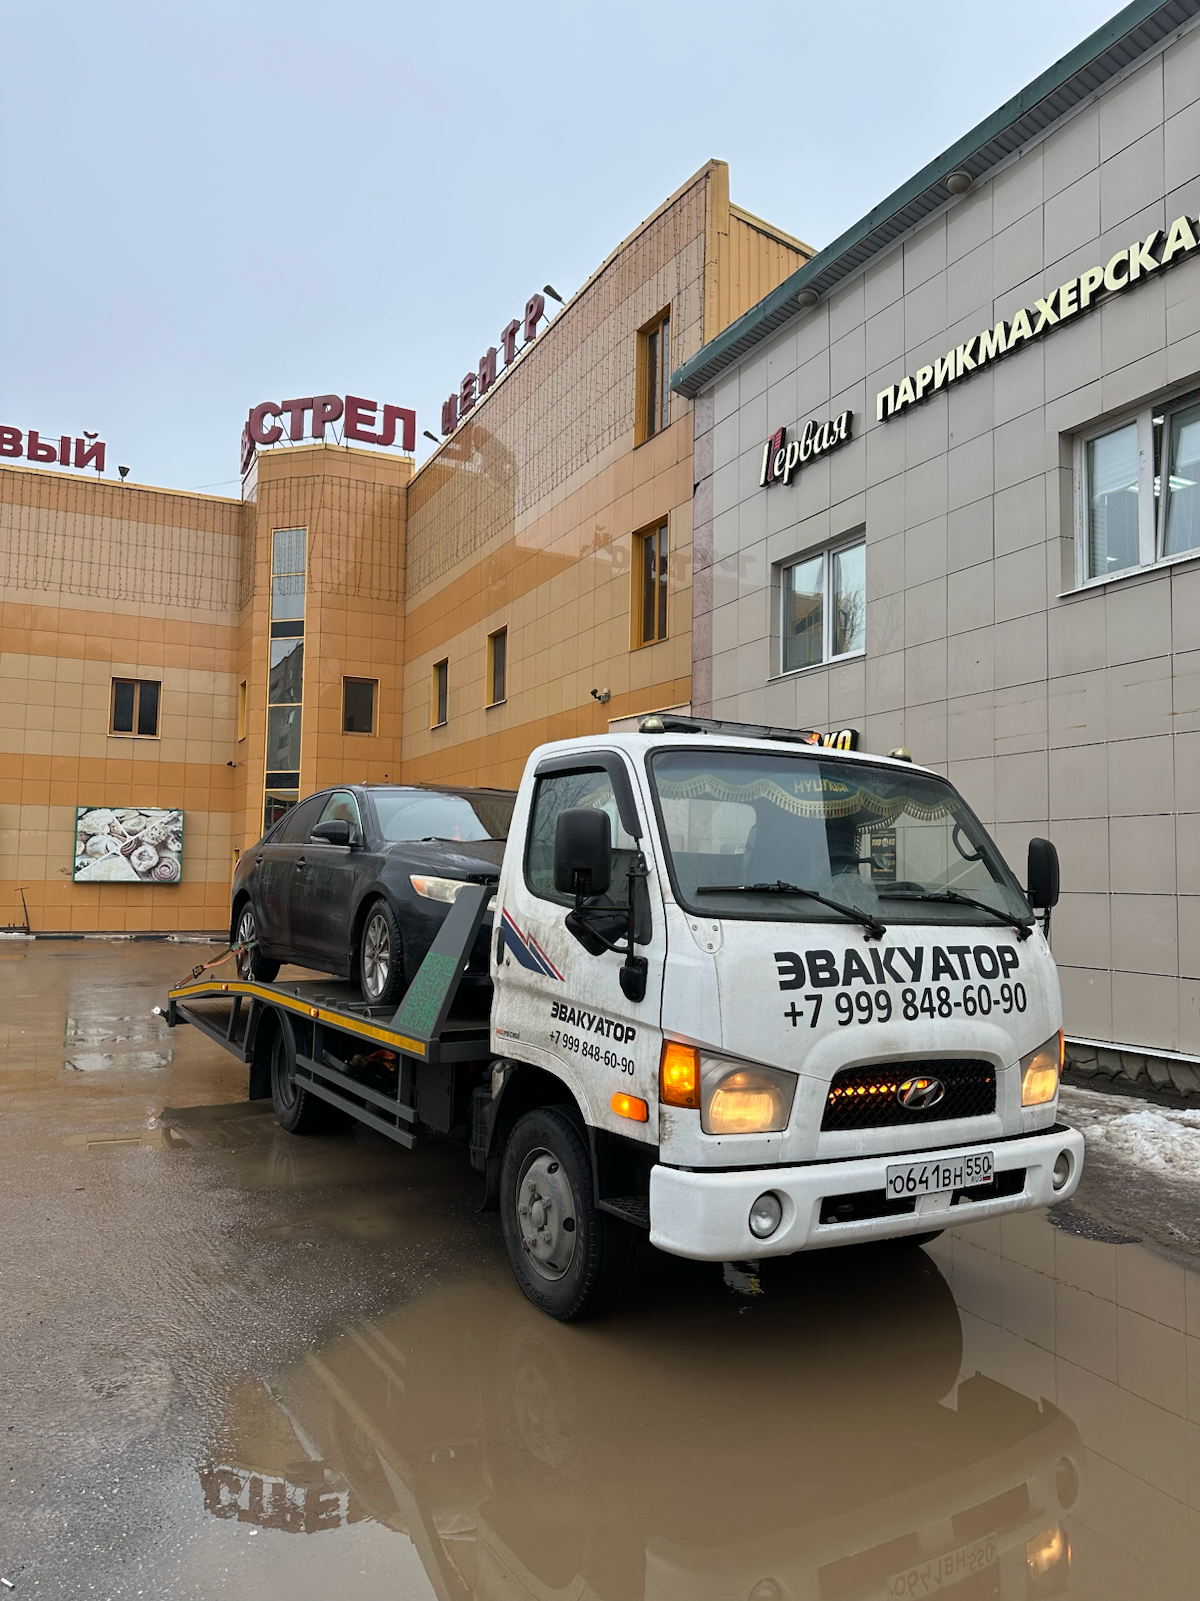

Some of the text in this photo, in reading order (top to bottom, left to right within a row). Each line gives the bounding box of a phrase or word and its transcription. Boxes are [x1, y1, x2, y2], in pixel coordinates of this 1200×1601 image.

[876, 214, 1200, 422] ПАРИКМАХЕРСКА
[441, 293, 545, 437] ЦЕНТР
[759, 410, 853, 488] Первая
[773, 945, 1020, 991] ЭВАКУАТОР
[550, 1001, 636, 1044] ЭВАКУАТОР
[784, 982, 1027, 1028] +7 999 848-60-90
[549, 1030, 635, 1076] +7 999 848-60-90
[966, 1156, 990, 1177] 550
